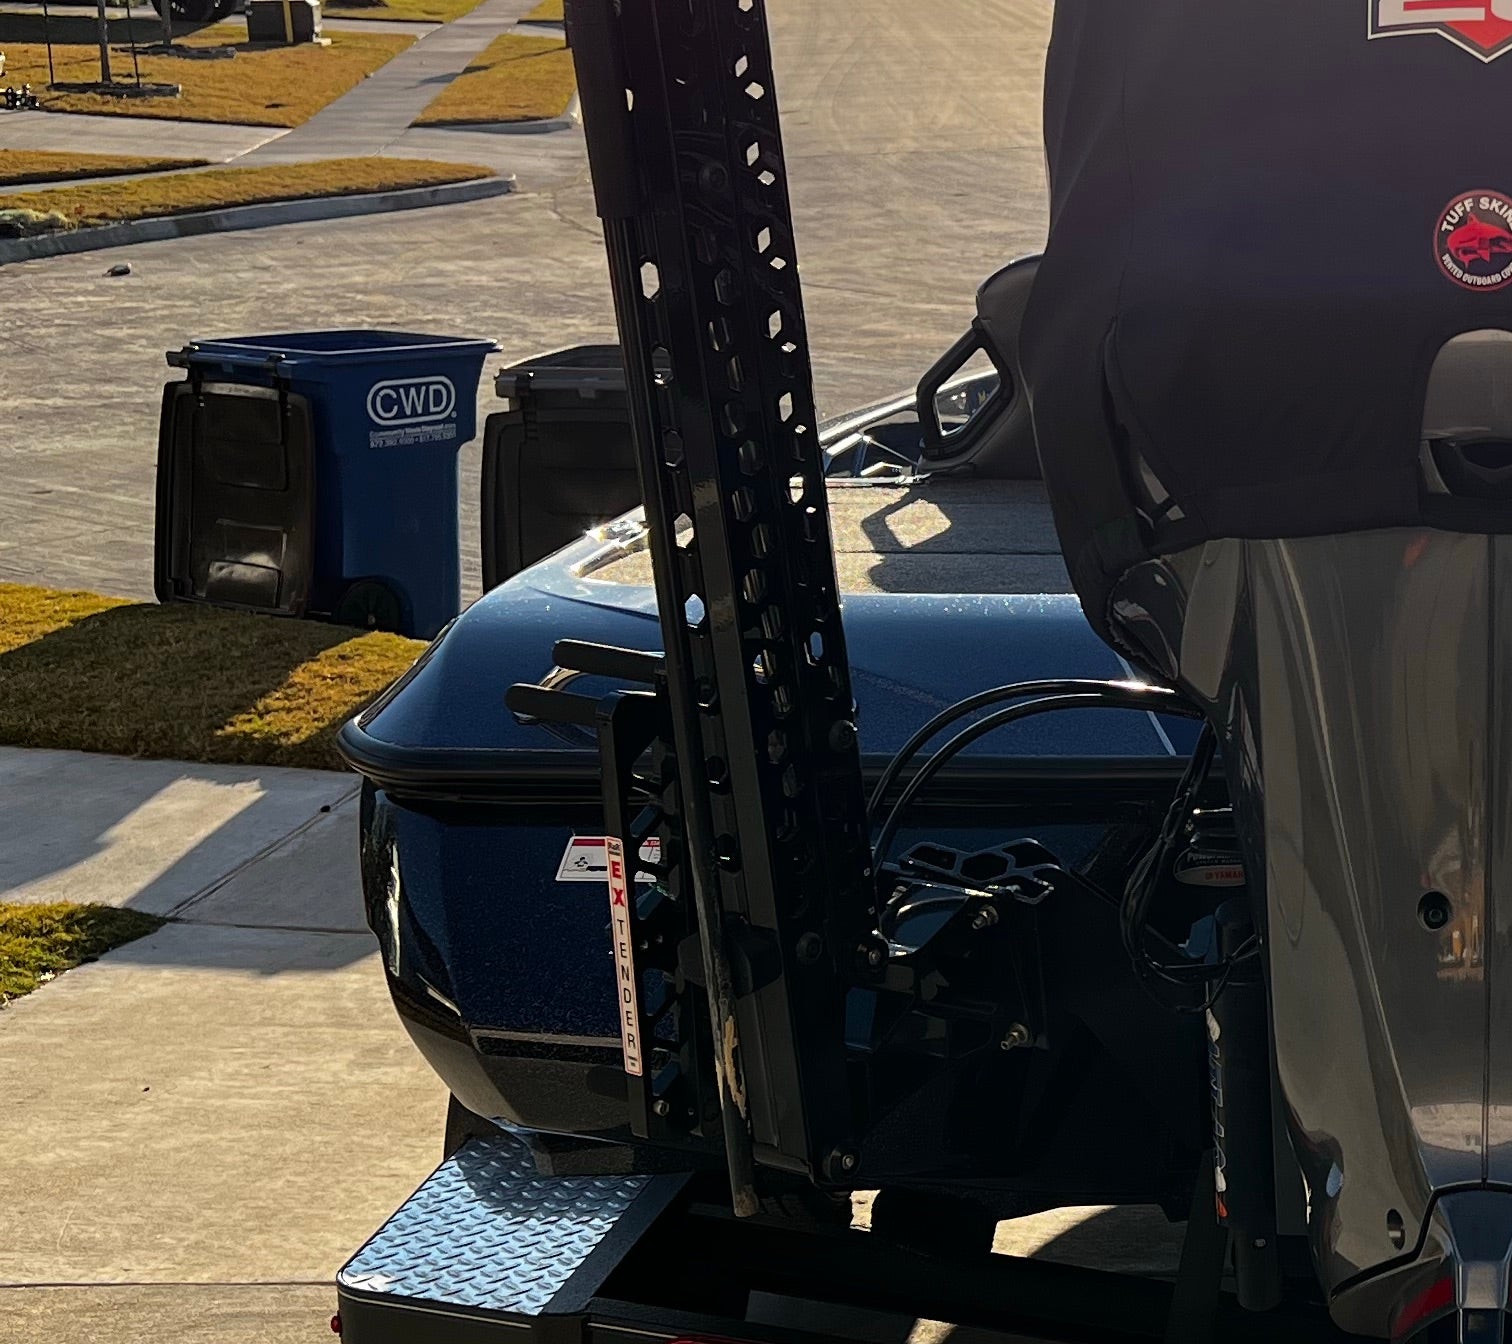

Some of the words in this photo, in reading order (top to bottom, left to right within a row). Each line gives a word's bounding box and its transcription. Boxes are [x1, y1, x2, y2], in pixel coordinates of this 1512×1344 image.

[1441, 198, 1474, 232] TUFF
[1462, 273, 1502, 286] OUTBOARD
[375, 384, 448, 418] CWD
